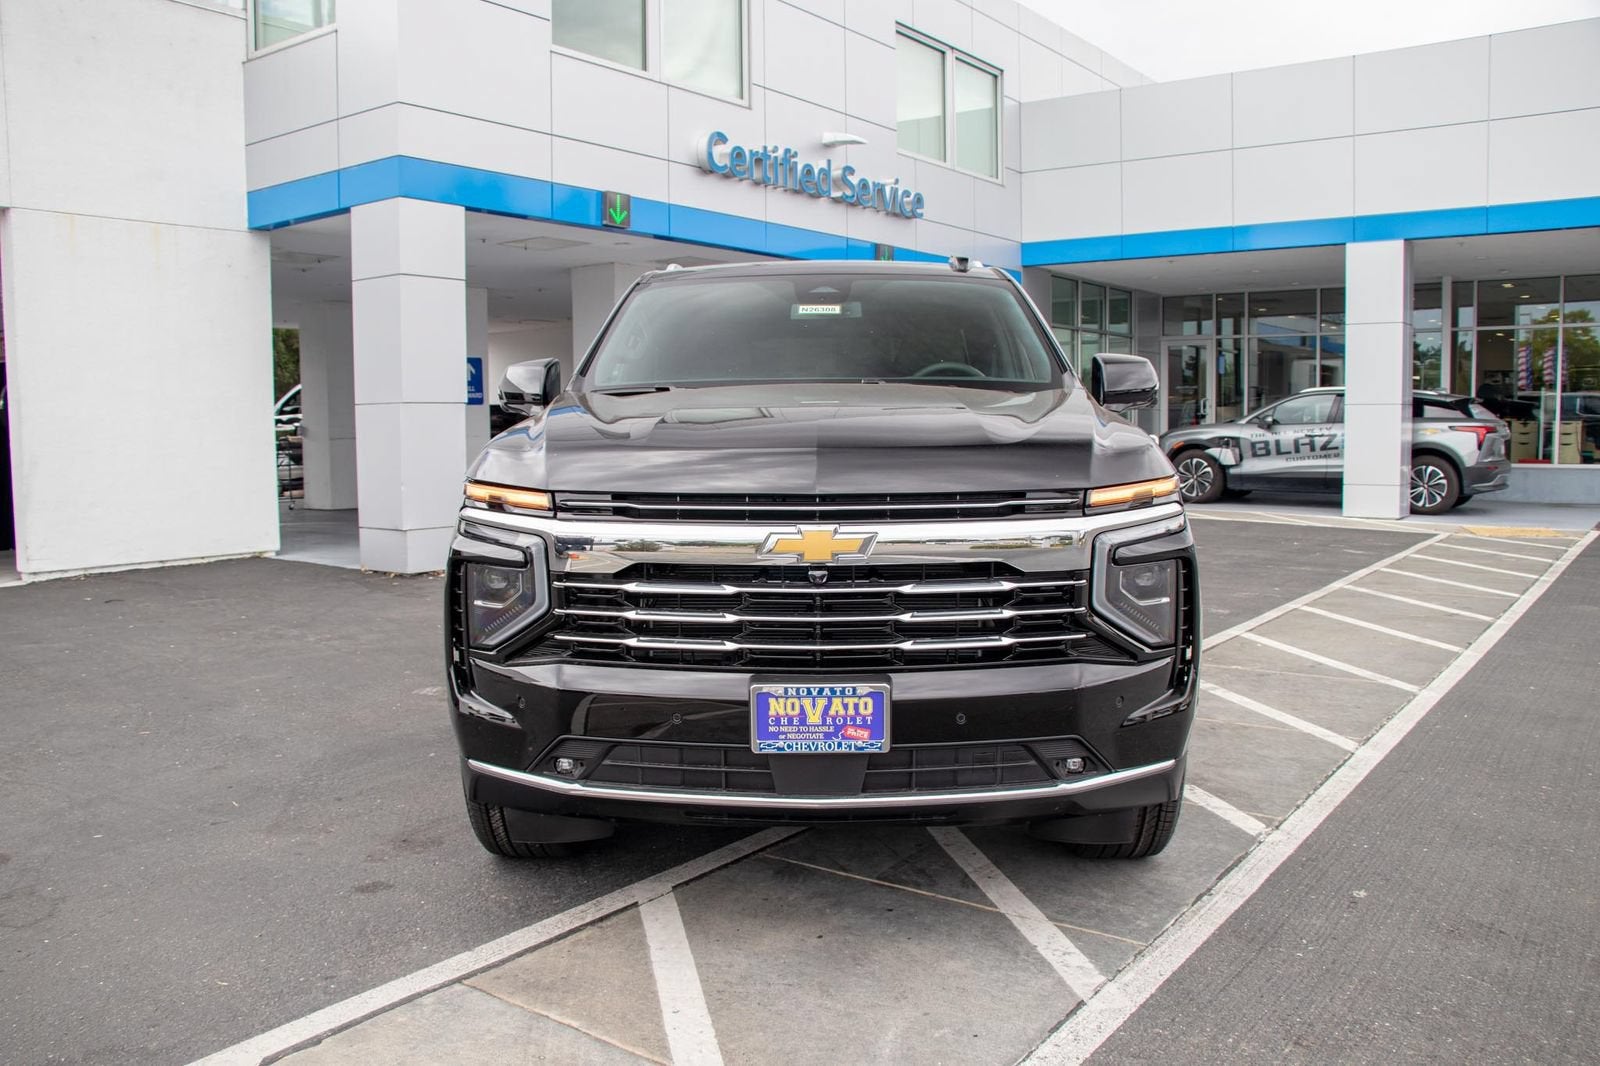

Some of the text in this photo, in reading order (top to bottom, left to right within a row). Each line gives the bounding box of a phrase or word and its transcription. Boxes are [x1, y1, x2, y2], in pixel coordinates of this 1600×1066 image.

[707, 131, 925, 219] Certified Service
[1250, 433, 1344, 458] BLAZ
[788, 687, 853, 696] NOVATO
[768, 697, 873, 725] NOVATO
[784, 741, 856, 751] CHEVROLET
